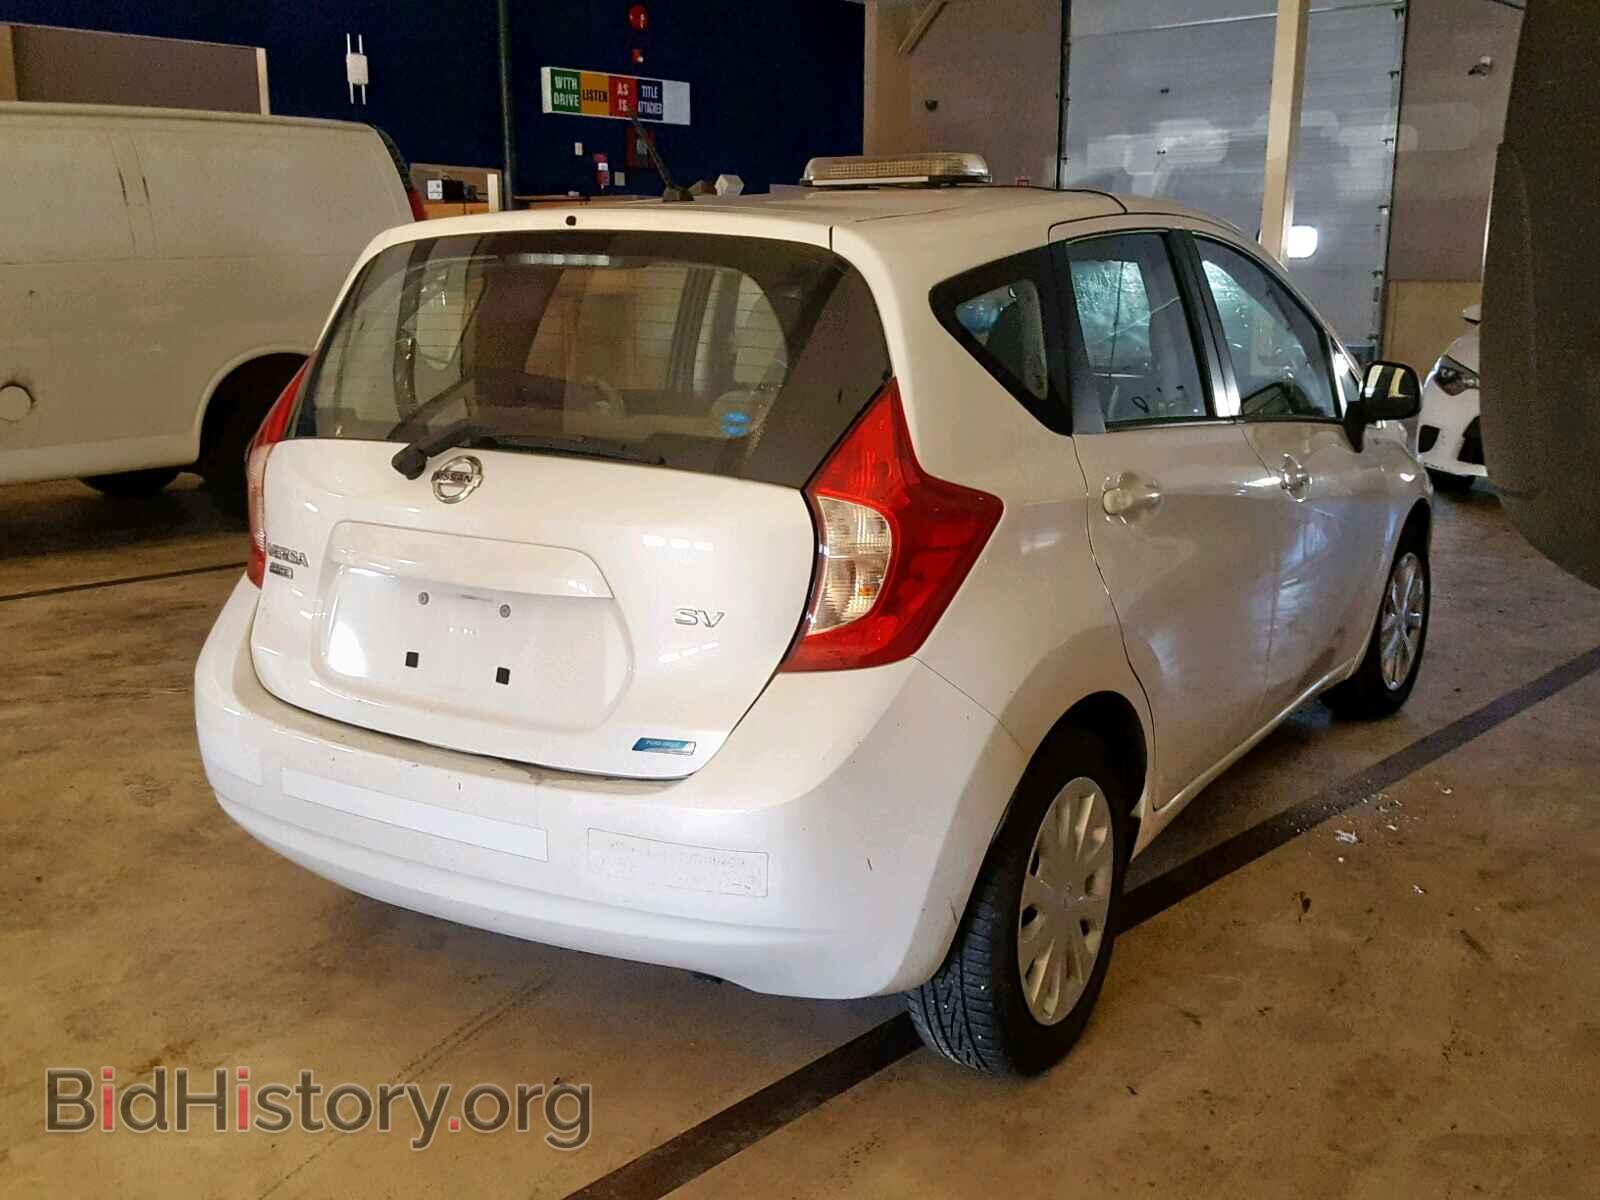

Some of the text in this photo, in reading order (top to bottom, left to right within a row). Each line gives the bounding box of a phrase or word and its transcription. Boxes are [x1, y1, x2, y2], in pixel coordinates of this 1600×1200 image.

[554, 75, 578, 90] WITH
[616, 82, 629, 96] AS
[582, 89, 608, 103] LISTEN
[641, 85, 659, 99] TITLE
[553, 92, 580, 107] DRIVE
[618, 98, 628, 112] IS
[638, 101, 663, 115] ATTACHED
[432, 471, 473, 482] NISSAN
[674, 608, 725, 628] SV
